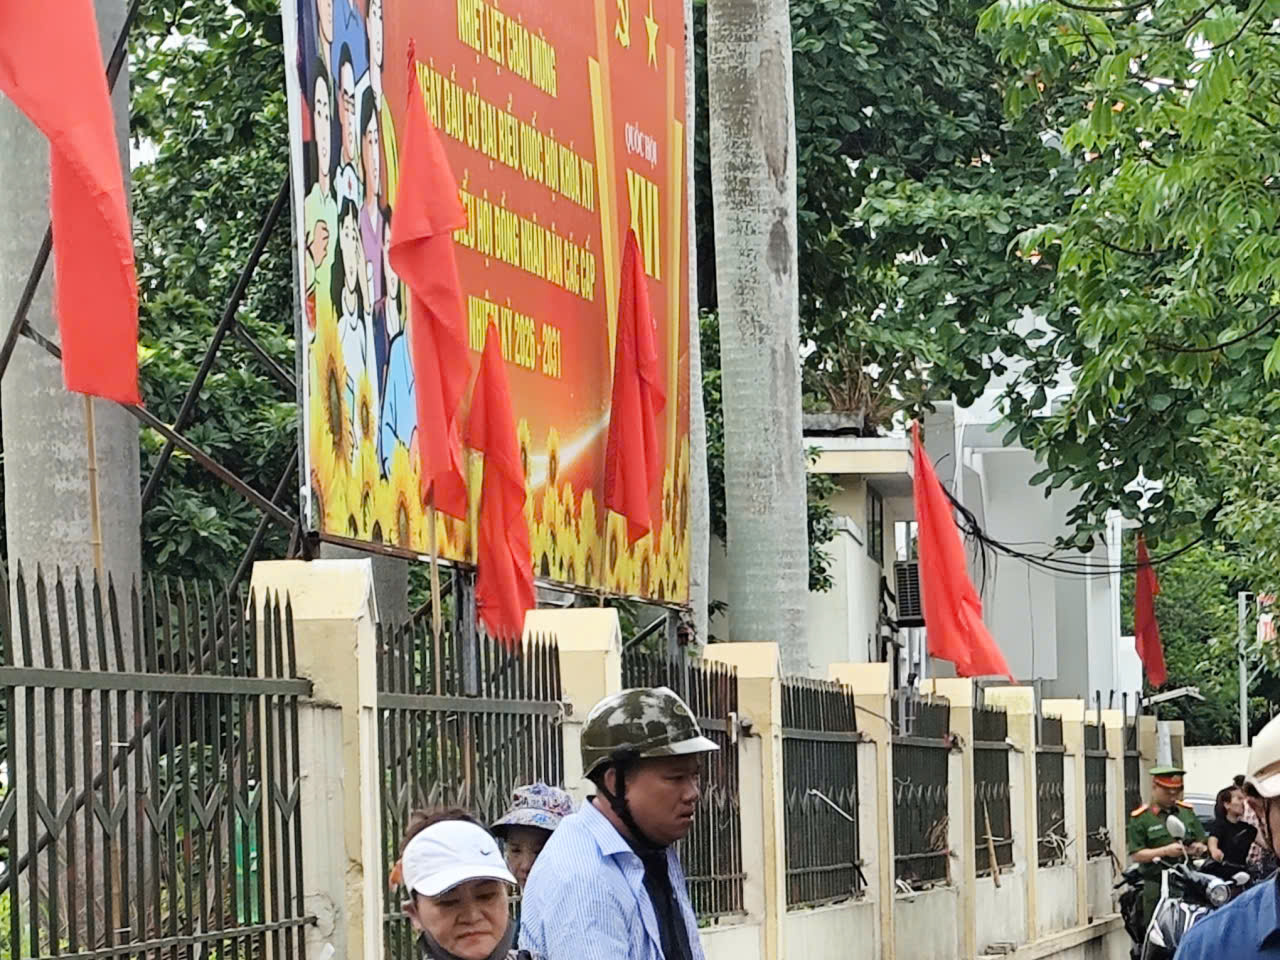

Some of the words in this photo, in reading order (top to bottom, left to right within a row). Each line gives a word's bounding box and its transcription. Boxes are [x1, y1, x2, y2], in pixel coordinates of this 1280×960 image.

[484, 0, 505, 75] LIỆT
[505, 12, 530, 81] CHÀO
[530, 27, 557, 98] MỪNG
[443, 64, 464, 142] BẦU
[465, 76, 480, 150] CỬ
[480, 98, 498, 170] ĐẠI
[498, 92, 519, 170] BIỂU
[520, 110, 544, 184] QUỐC
[544, 128, 560, 202] HỘI
[559, 141, 581, 205] KHÓA
[581, 157, 595, 213] XVI
[625, 121, 645, 157] QUỐC
[645, 135, 657, 169] HỘI
[476, 188, 494, 267] HỘI
[494, 190, 520, 267] ĐỒNG
[520, 212, 545, 278] NHÂN
[545, 221, 563, 286] DÂN
[563, 231, 580, 295] CÁC
[580, 233, 596, 302] CẤP
[626, 168, 661, 281] XVI
[500, 297, 513, 361] KỲ
[514, 311, 536, 371] 2026
